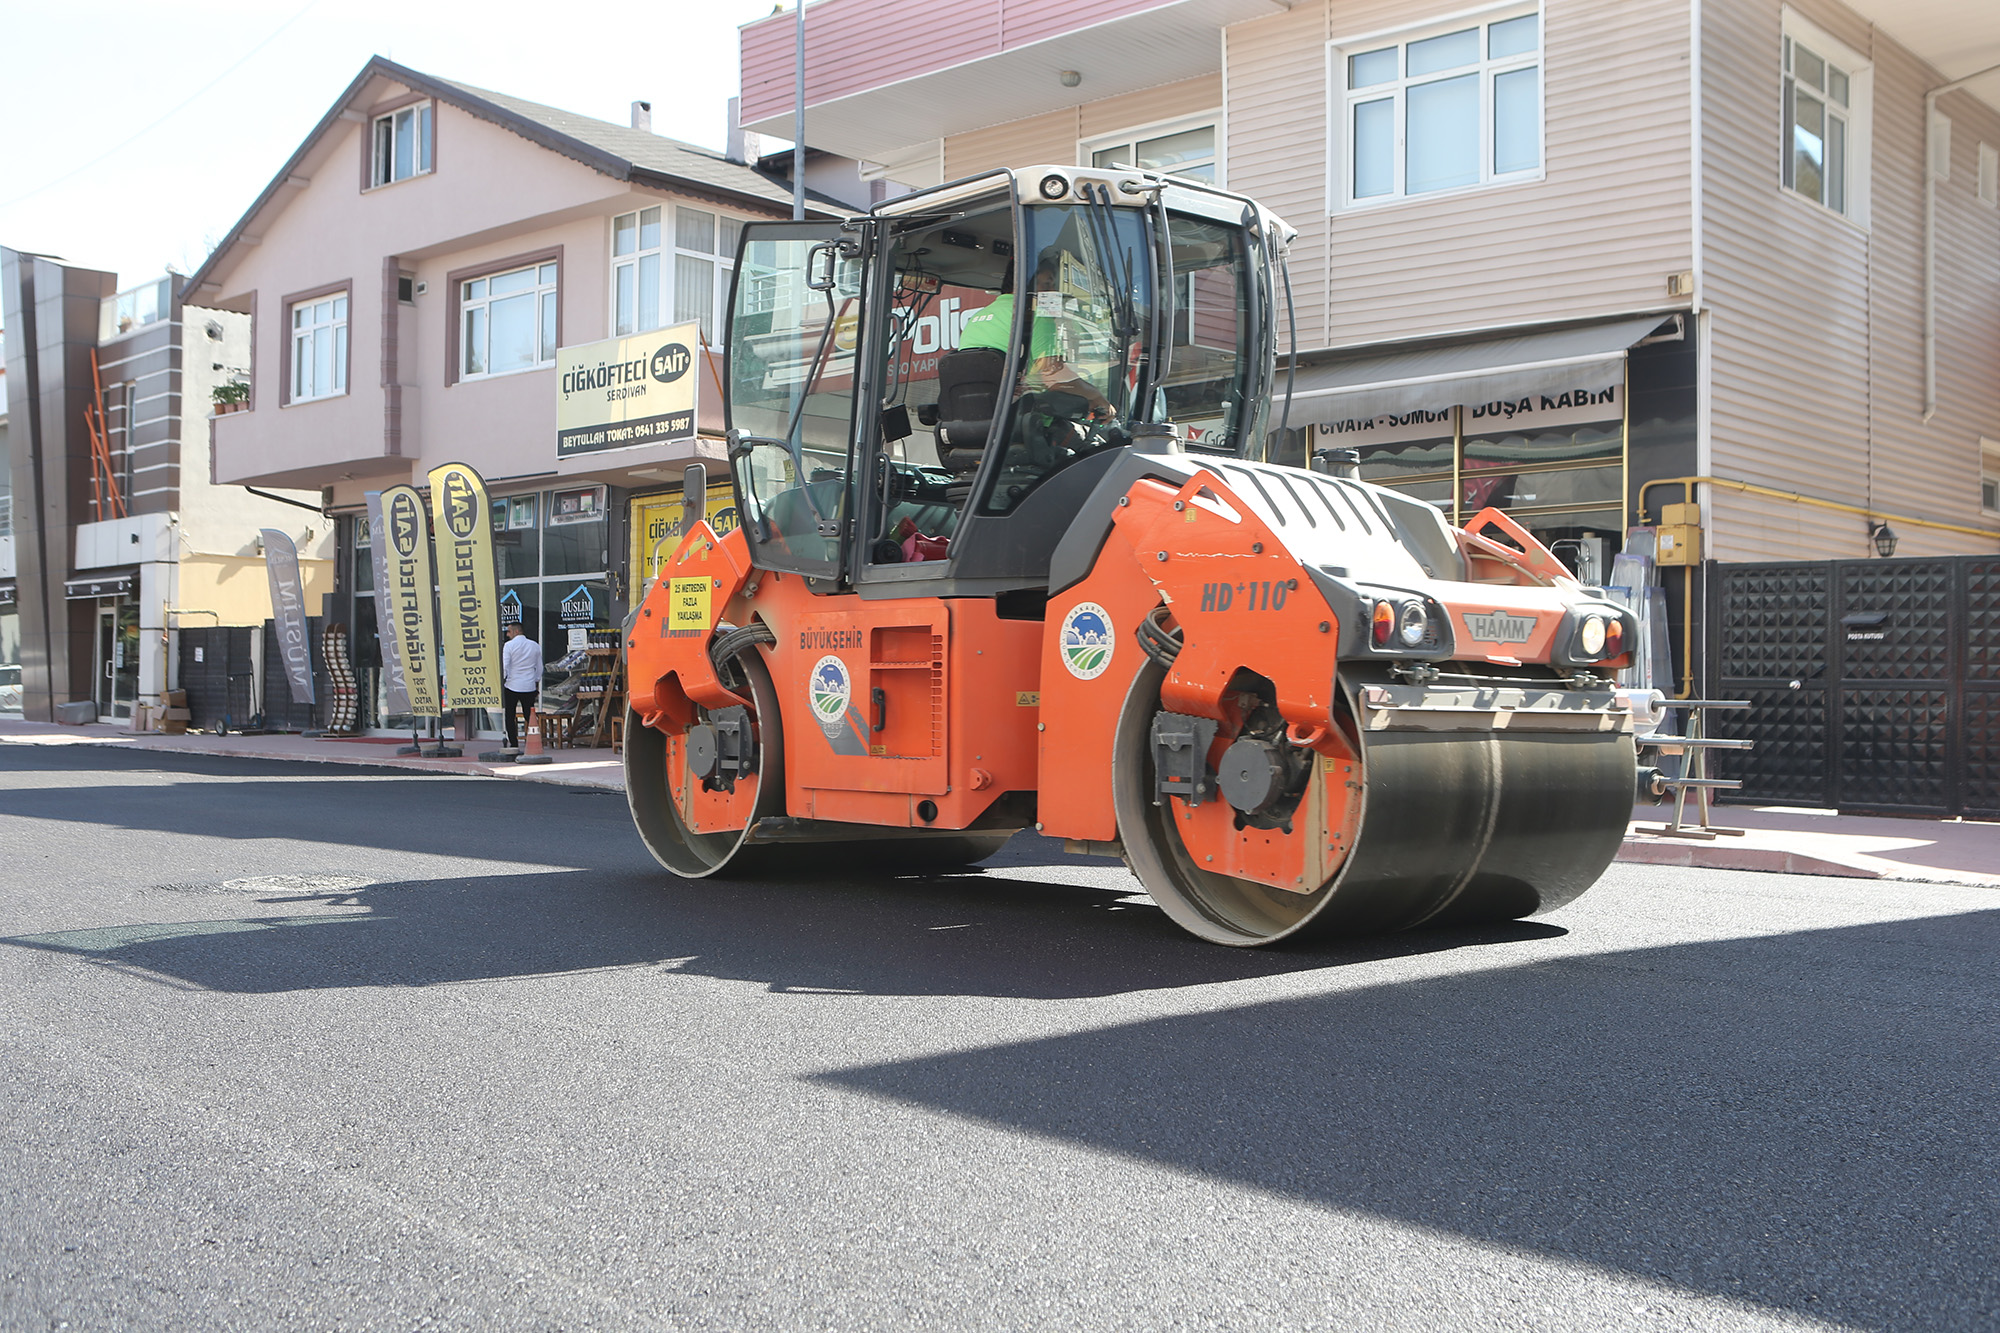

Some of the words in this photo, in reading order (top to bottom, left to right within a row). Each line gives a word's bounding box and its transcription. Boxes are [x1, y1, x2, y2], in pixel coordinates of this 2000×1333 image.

[562, 352, 647, 401] ÇİĞKÖFTECİ
[654, 348, 686, 376] SAİT
[912, 358, 938, 373] YAPI
[606, 384, 647, 402] SERDİVAN
[562, 431, 605, 448] BEYTULLAH
[606, 426, 634, 442] TOKAT:
[635, 423, 654, 438] 0541
[655, 421, 669, 435] 335
[670, 417, 690, 432] 5987
[714, 510, 739, 533] SAİ
[675, 584, 681, 593] 25
[681, 583, 707, 593] METREDEN
[561, 599, 591, 613] MÜSLİM
[683, 597, 697, 606] FAZLA
[677, 611, 703, 622] YAKLAŞMA
[1475, 617, 1525, 639] HAMM
[800, 625, 863, 652] BÜYÜKŞEHİR
